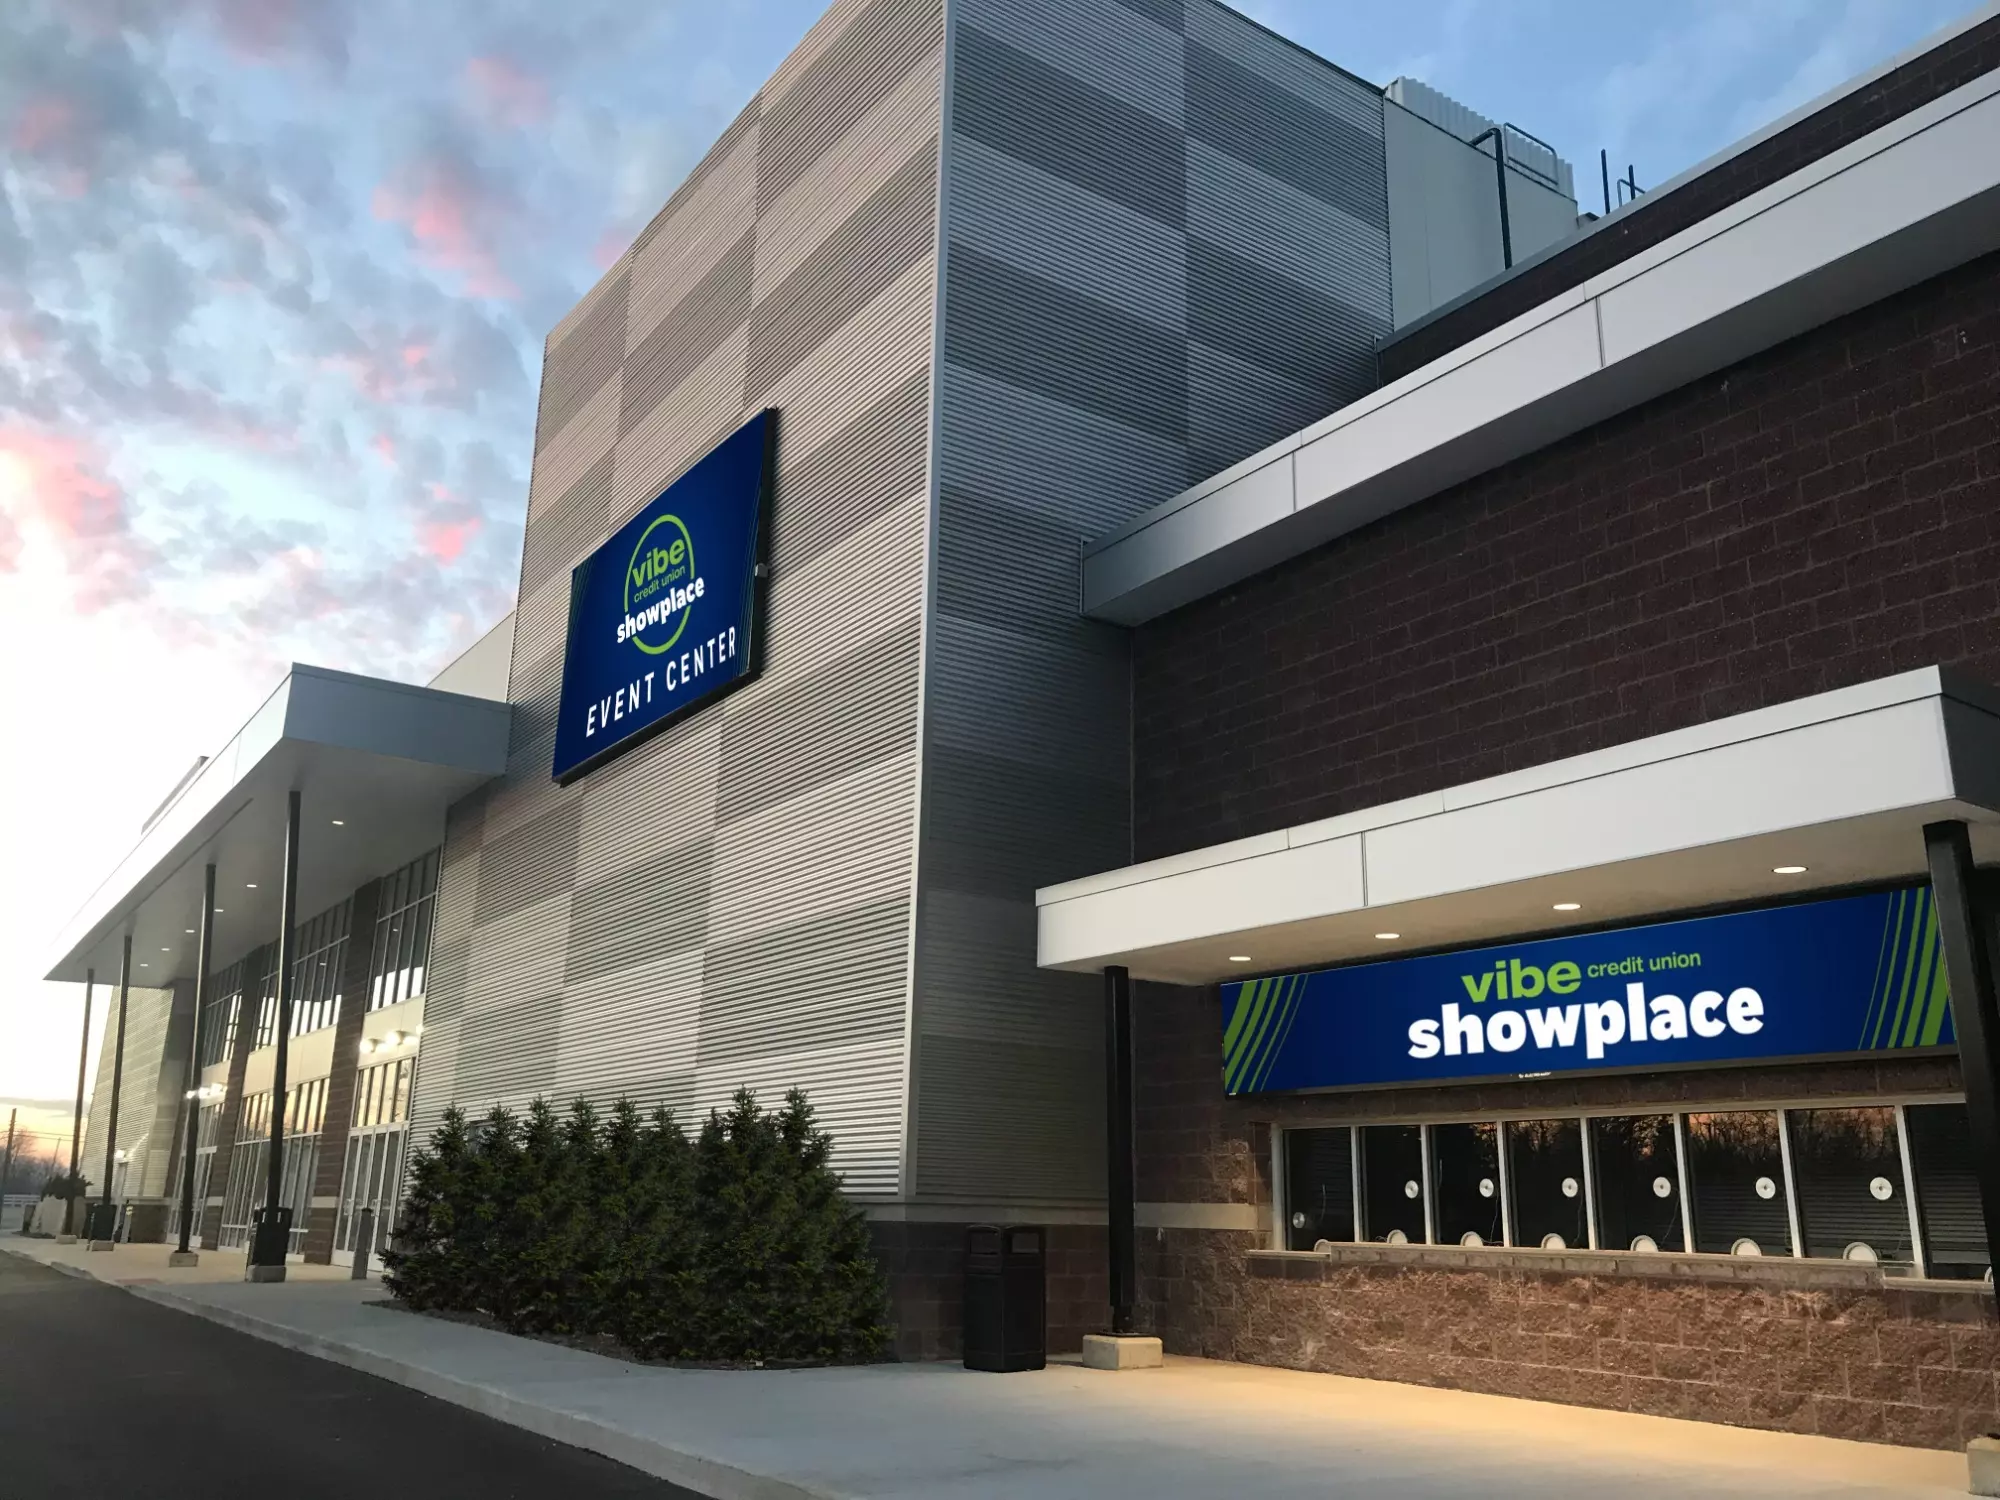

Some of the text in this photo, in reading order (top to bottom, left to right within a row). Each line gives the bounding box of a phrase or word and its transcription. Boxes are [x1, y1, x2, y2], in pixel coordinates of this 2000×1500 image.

[632, 538, 686, 588] vibe
[634, 565, 686, 604] credit union
[616, 577, 705, 643] showplace
[585, 626, 736, 738] EVENT CENTER
[1461, 952, 1702, 1003] vibe credit union
[1407, 981, 1765, 1060] showplace
